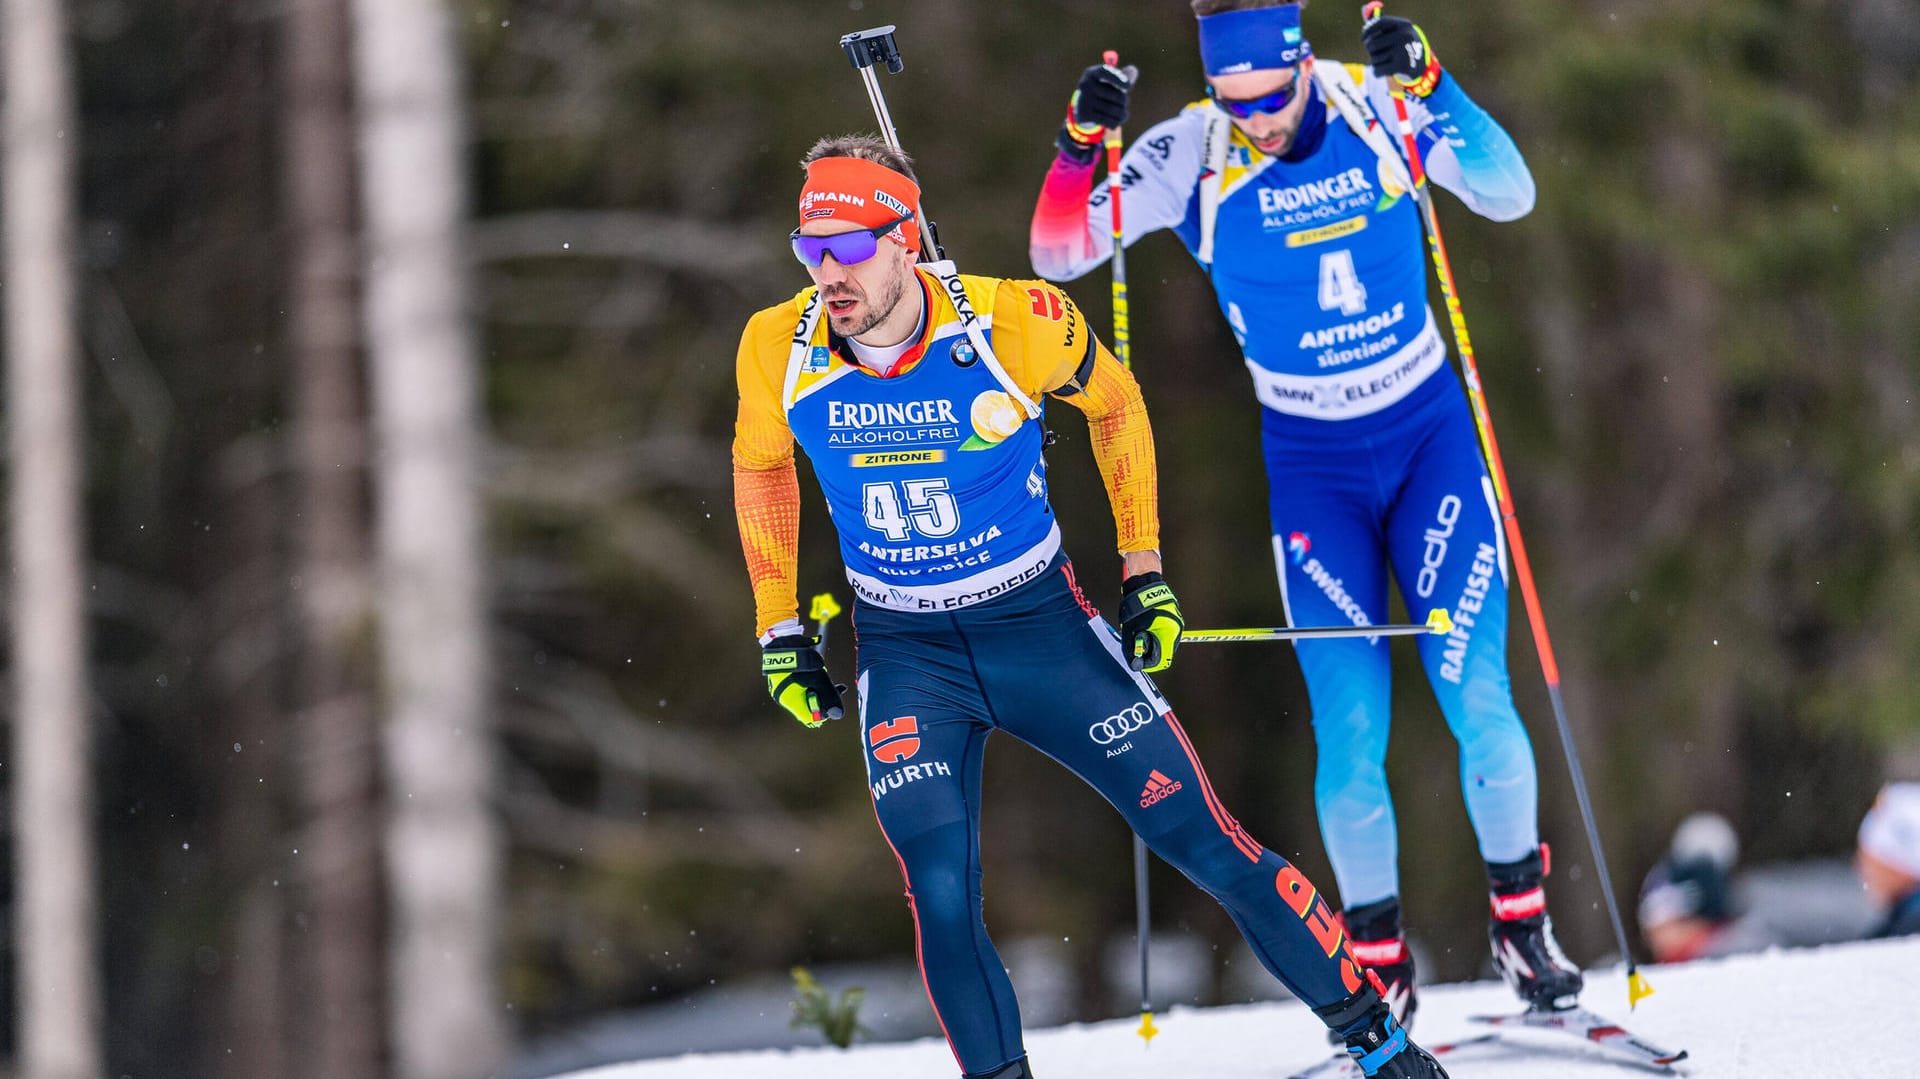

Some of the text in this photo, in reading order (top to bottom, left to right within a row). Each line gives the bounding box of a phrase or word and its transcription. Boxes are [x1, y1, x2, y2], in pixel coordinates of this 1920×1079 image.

[1257, 167, 1373, 214] ERDINGER
[940, 274, 977, 327] JOKA
[1317, 249, 1367, 317] 4
[791, 290, 819, 348] JOKA
[1060, 288, 1076, 347] WÜRT
[1299, 302, 1404, 349] ANTHOLZ
[828, 399, 960, 429] ERDINGER
[1271, 384, 1314, 403] BMW
[828, 427, 960, 443] ALKOHOLFREI
[865, 453, 932, 464] ZITRONE
[863, 477, 960, 541] 45
[858, 525, 1002, 563] ANTERSELVA
[1416, 494, 1462, 598] odlo
[1439, 542, 1496, 684] RAIFFEISEN
[1106, 741, 1133, 758] Audi
[872, 761, 951, 801] WÜRTH
[1140, 781, 1182, 808] adidas
